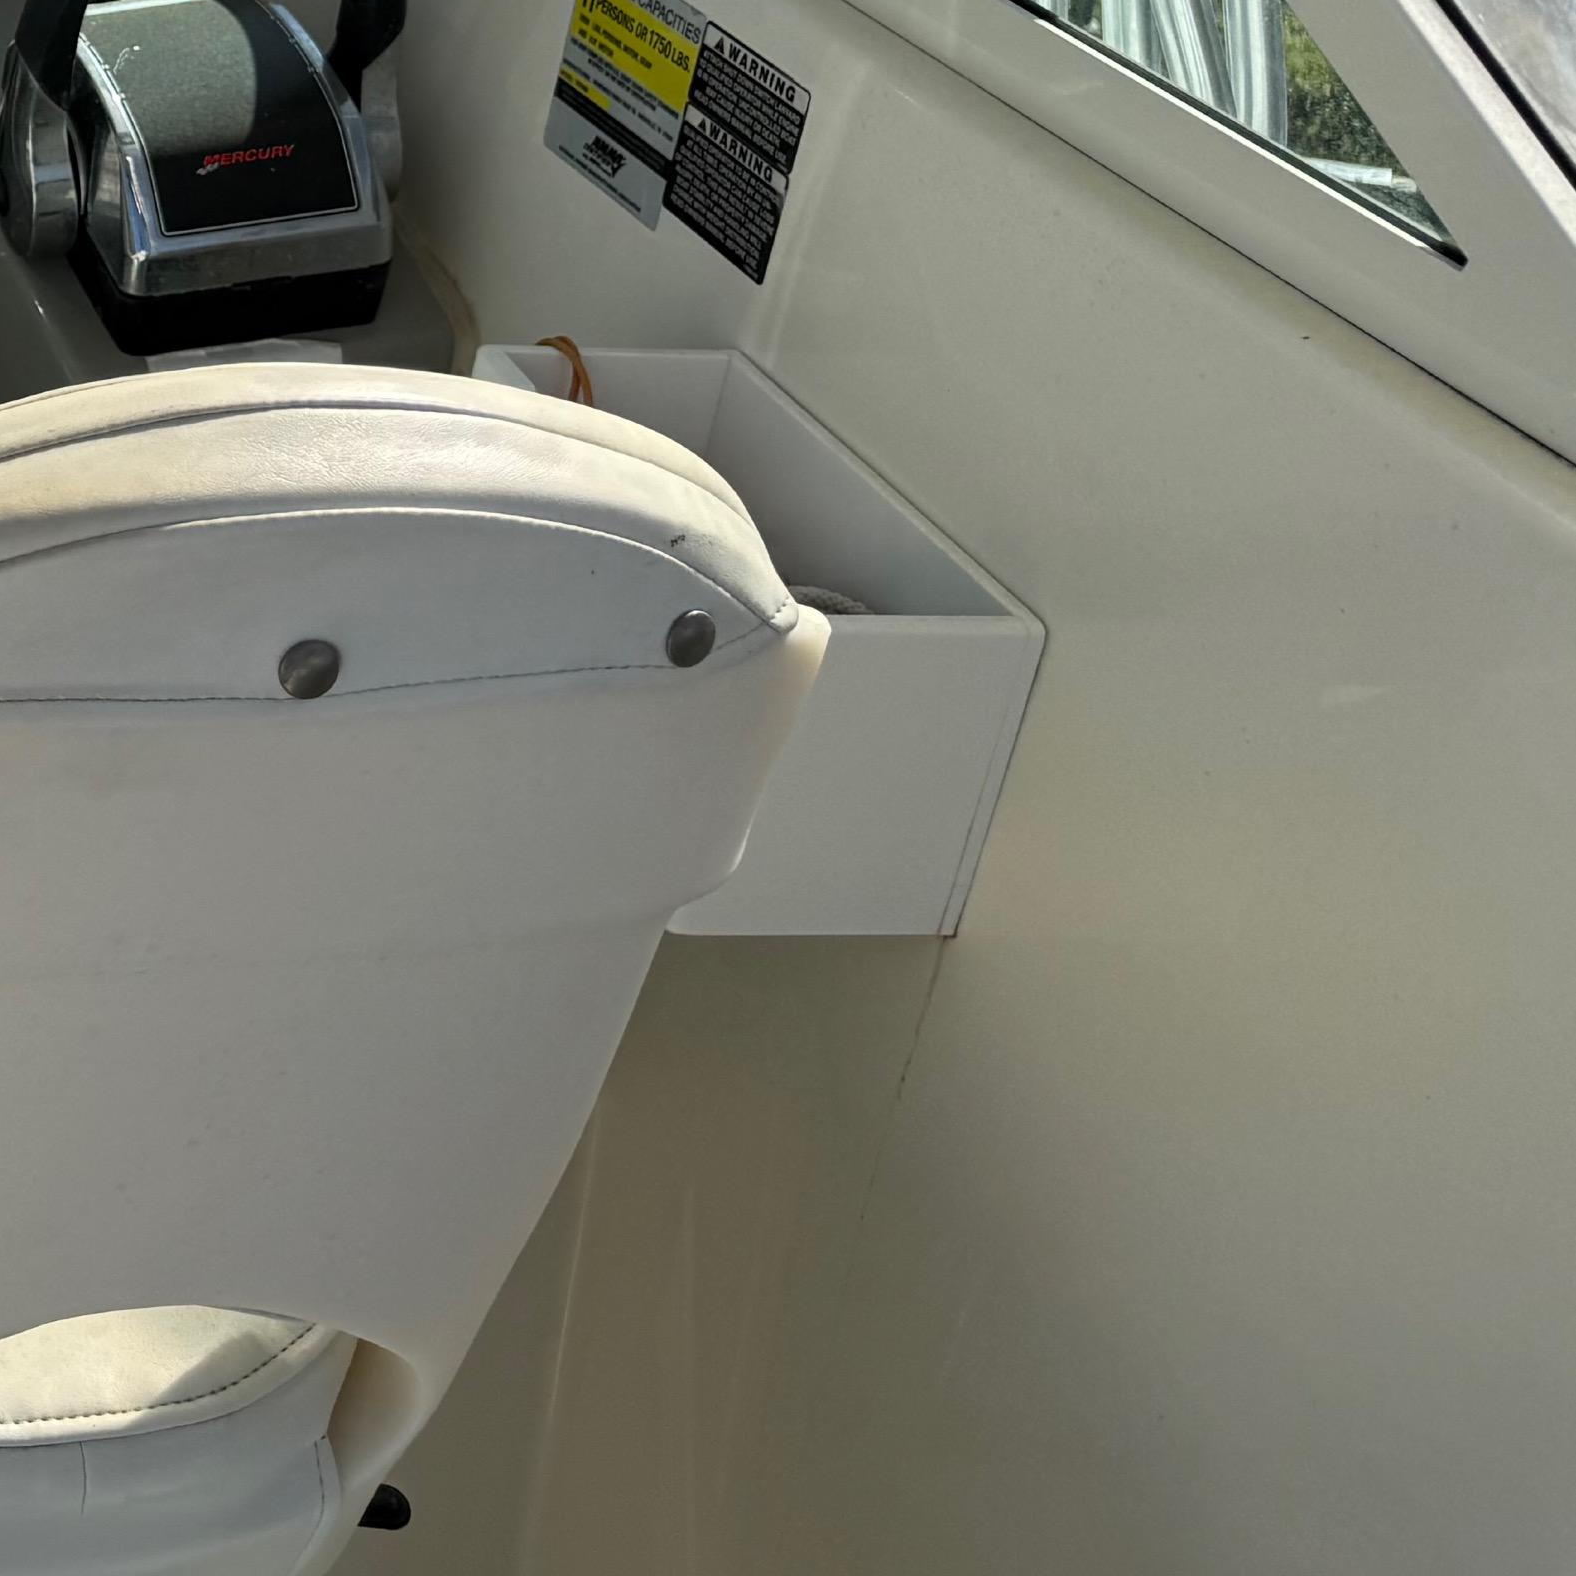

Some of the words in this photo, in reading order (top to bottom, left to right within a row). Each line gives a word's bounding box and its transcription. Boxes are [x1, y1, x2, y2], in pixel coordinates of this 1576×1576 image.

[635, 22, 647, 42] OR
[649, 29, 672, 58] 1750
[672, 48, 690, 73] LBS.
[729, 42, 796, 102] WARNING
[203, 144, 295, 167] MERCURY
[710, 124, 773, 182] WARNING
